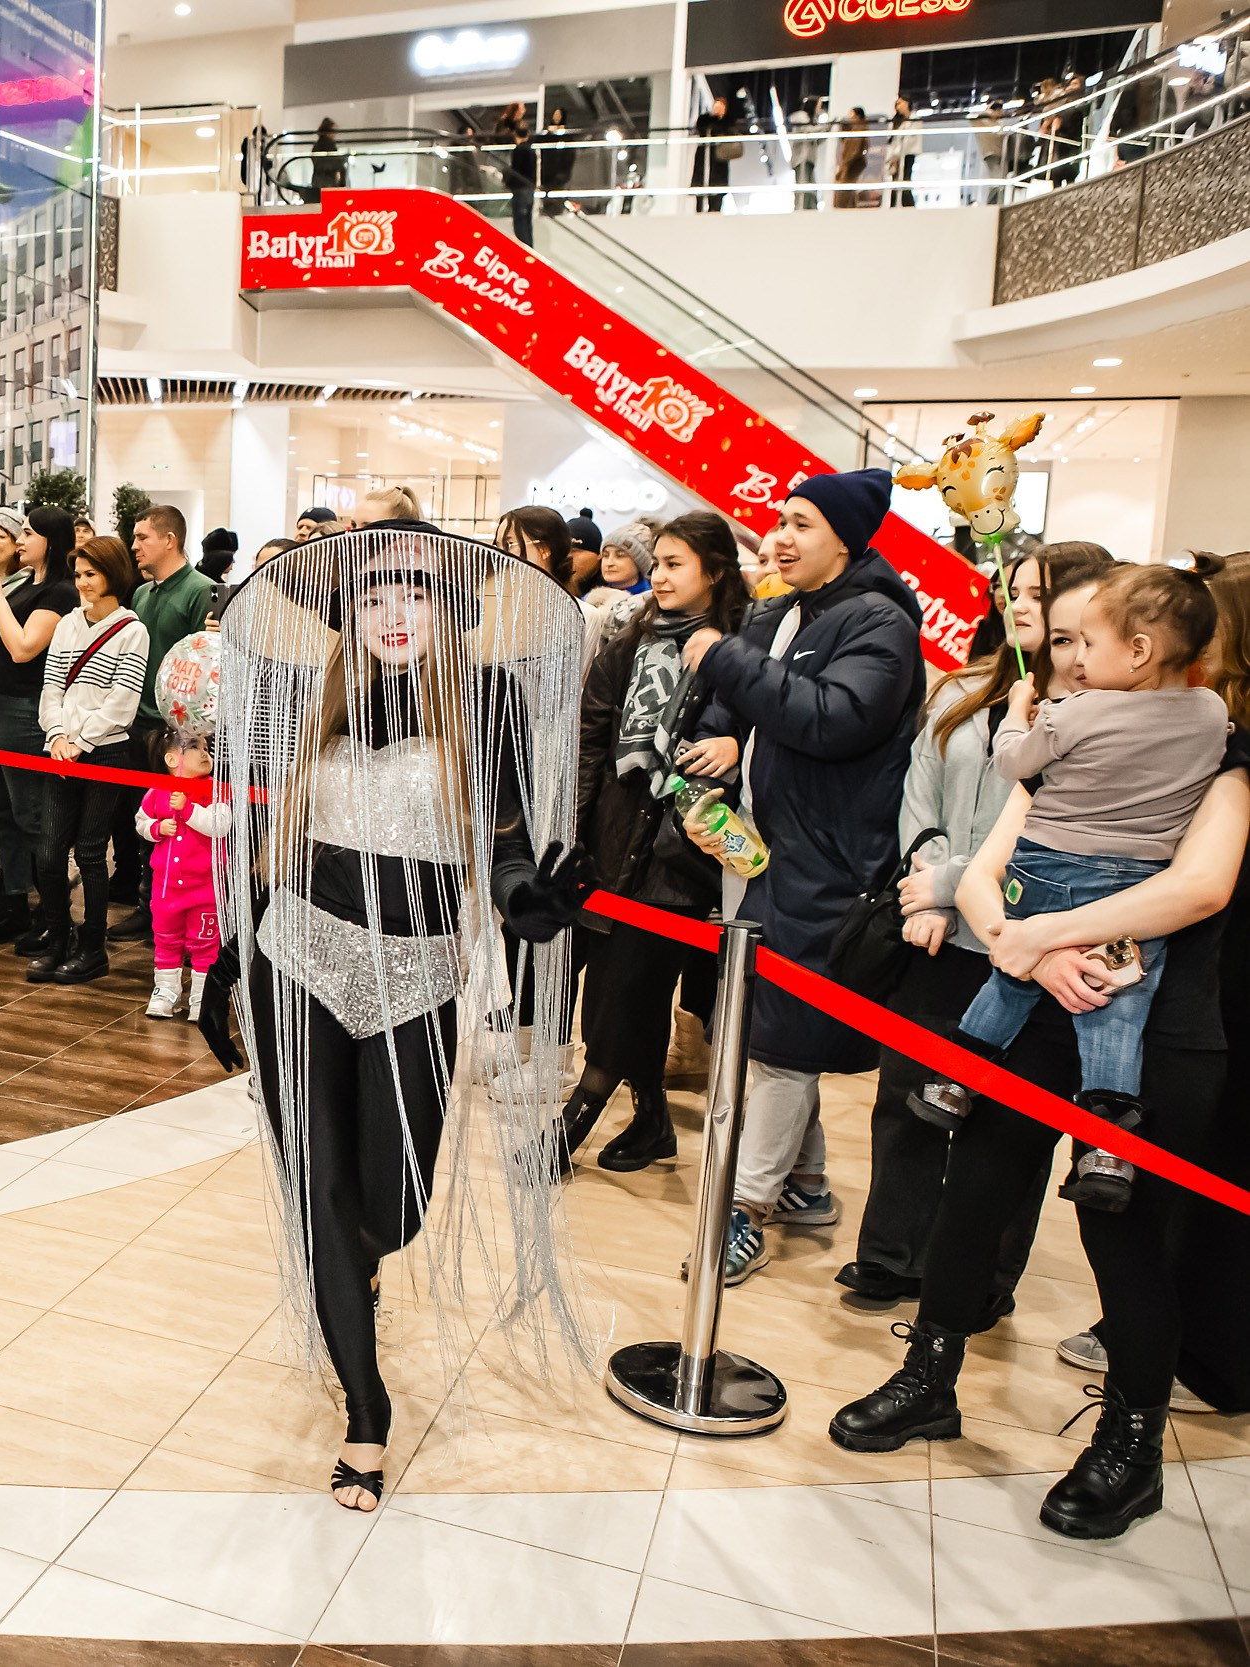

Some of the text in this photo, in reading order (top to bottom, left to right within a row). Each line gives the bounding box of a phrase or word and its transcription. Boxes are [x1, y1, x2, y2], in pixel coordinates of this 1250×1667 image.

[250, 231, 329, 268] Batyr
[315, 254, 355, 268] mall
[420, 240, 534, 316] Вместе
[473, 246, 530, 295] Бірге
[563, 336, 643, 405] Batyr
[612, 400, 653, 432] mall
[166, 673, 197, 695] ГОДА
[173, 658, 202, 678] МАТЬ
